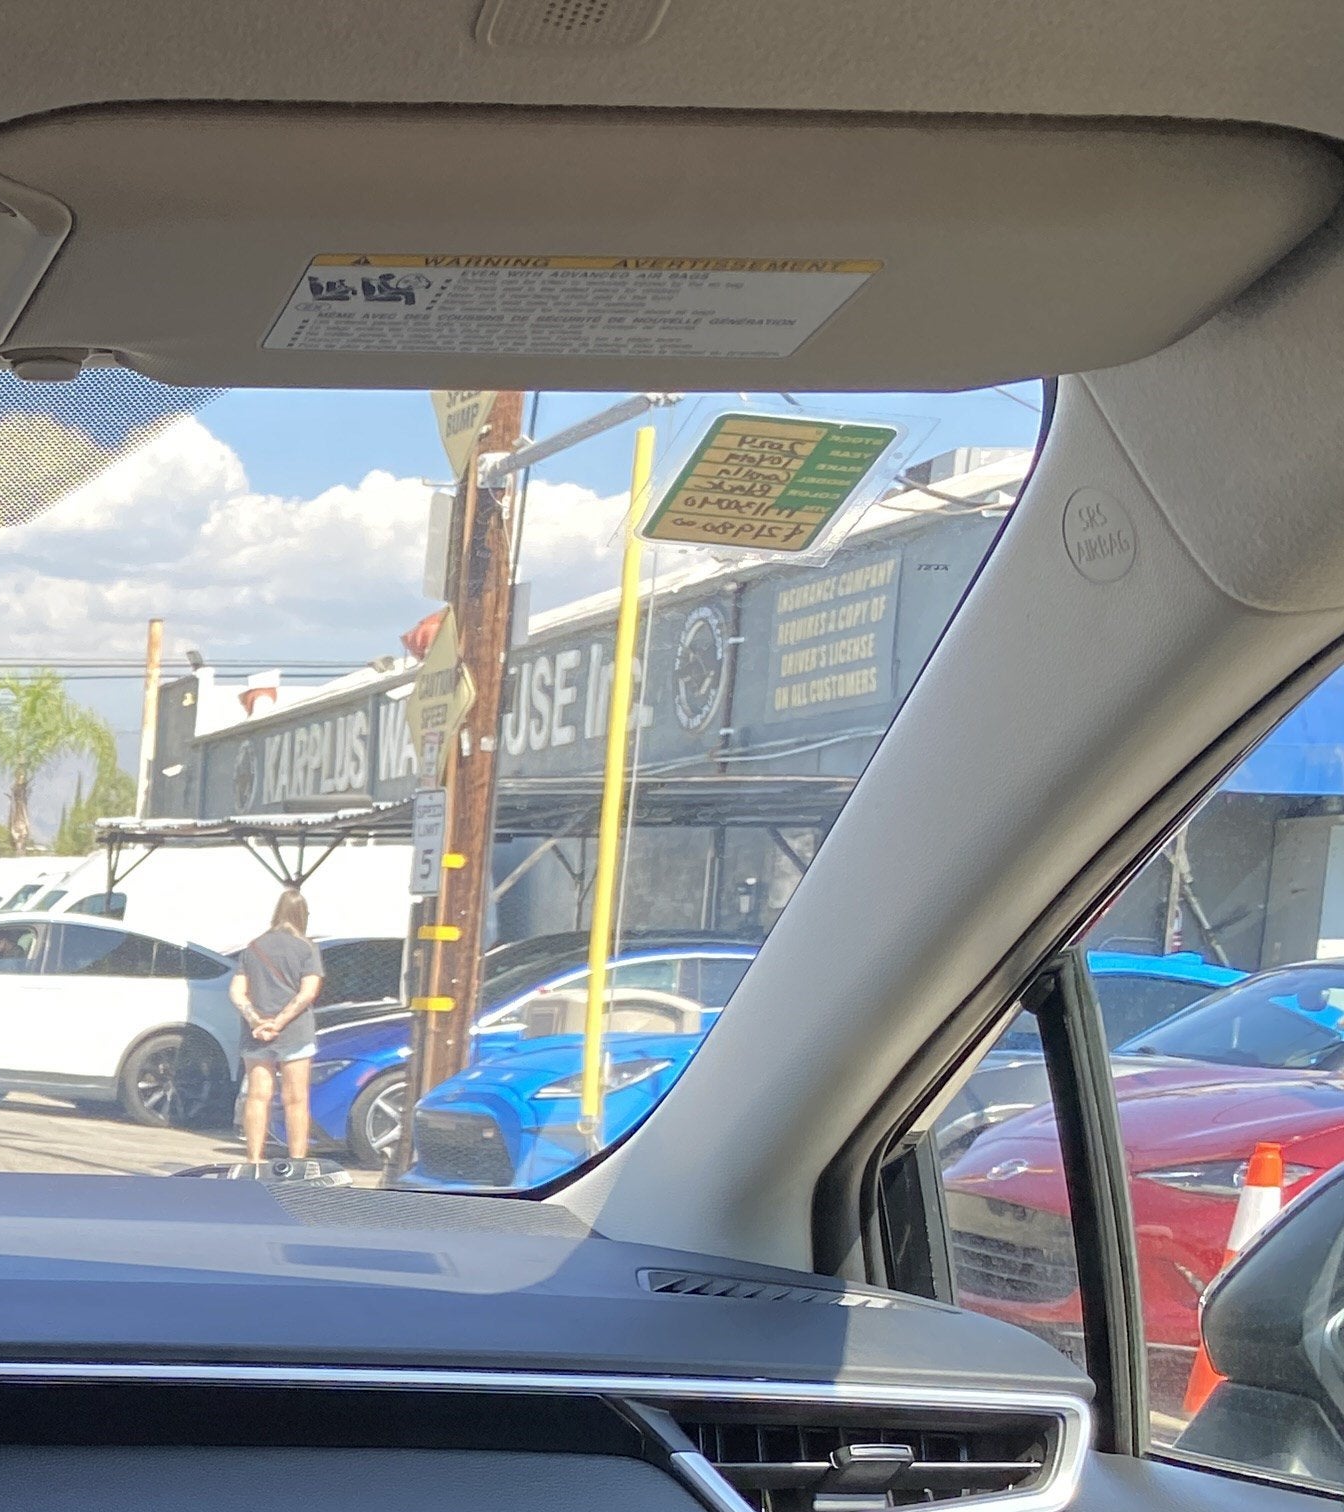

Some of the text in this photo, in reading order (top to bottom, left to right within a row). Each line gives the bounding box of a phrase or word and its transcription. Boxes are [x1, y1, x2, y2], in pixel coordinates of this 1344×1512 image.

[424, 255, 551, 267] WARNING
[1079, 503, 1108, 531] SRS
[837, 559, 896, 597] COMPANY
[838, 600, 870, 631] COPY
[870, 594, 886, 622] OF
[829, 632, 875, 667] LICENSE
[810, 666, 877, 703] CUSTOMERS
[263, 711, 369, 805] KARPLUS
[416, 804, 443, 819] SPEED
[420, 850, 435, 879] 5
